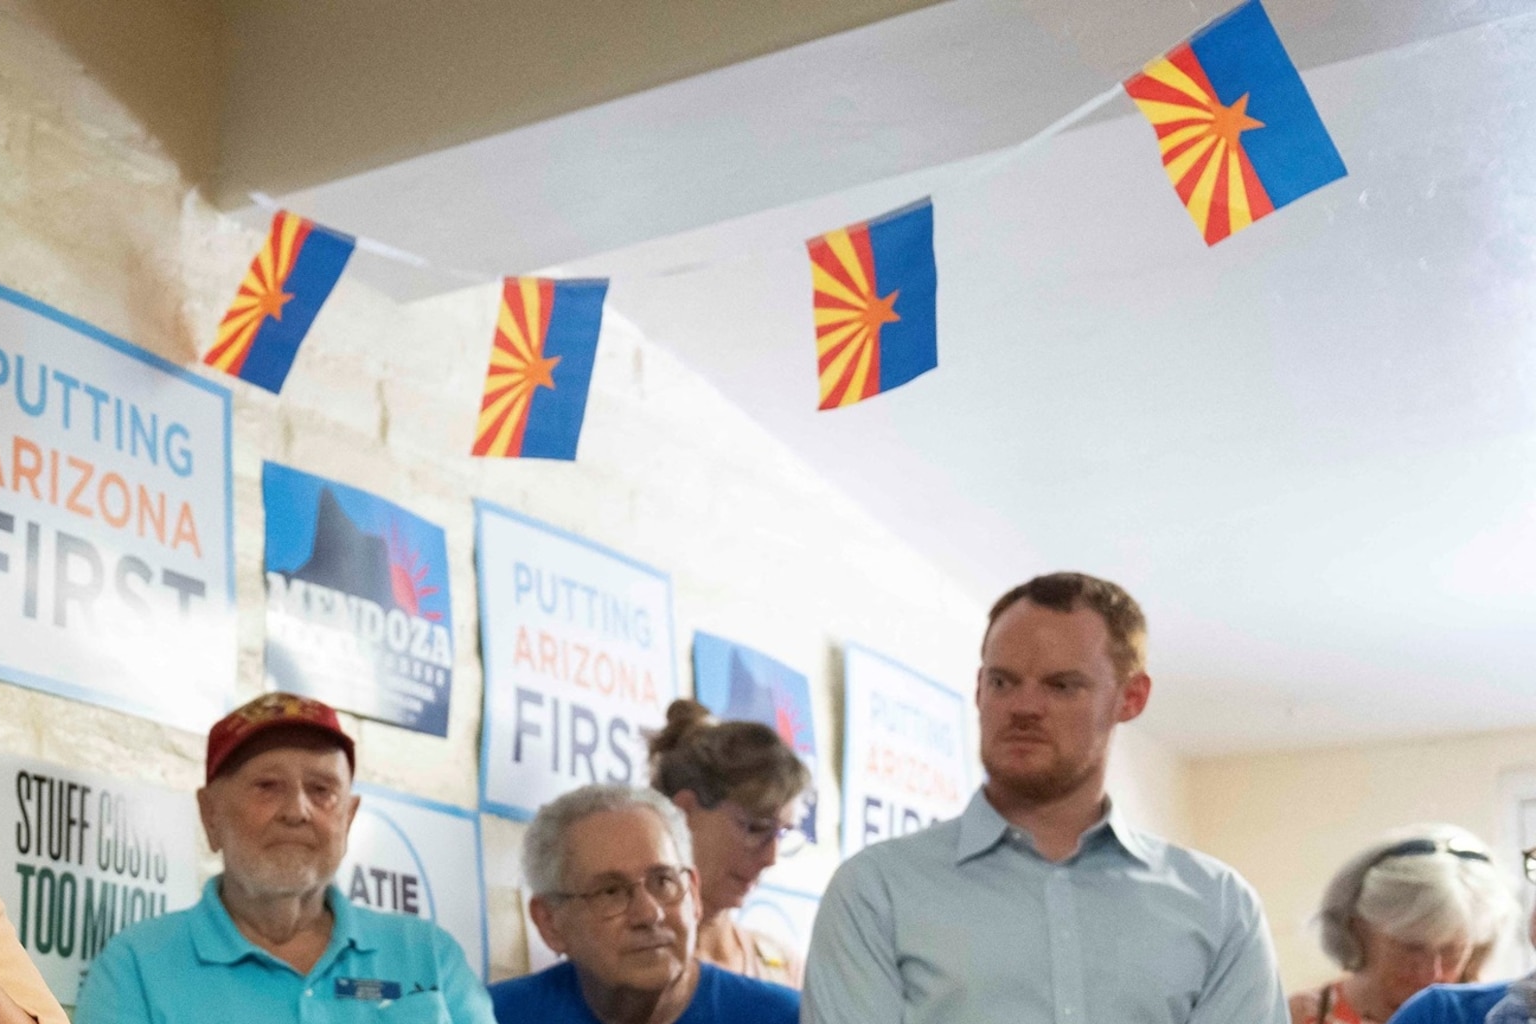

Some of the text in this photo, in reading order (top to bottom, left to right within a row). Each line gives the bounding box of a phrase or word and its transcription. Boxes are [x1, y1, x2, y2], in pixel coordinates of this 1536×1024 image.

[514, 561, 652, 648] PUTTING
[513, 624, 660, 705] ARIZONA
[512, 686, 664, 784] FIRS
[15, 770, 92, 866] STUFF
[16, 862, 77, 958] TOO
[349, 865, 420, 914] ATIE
